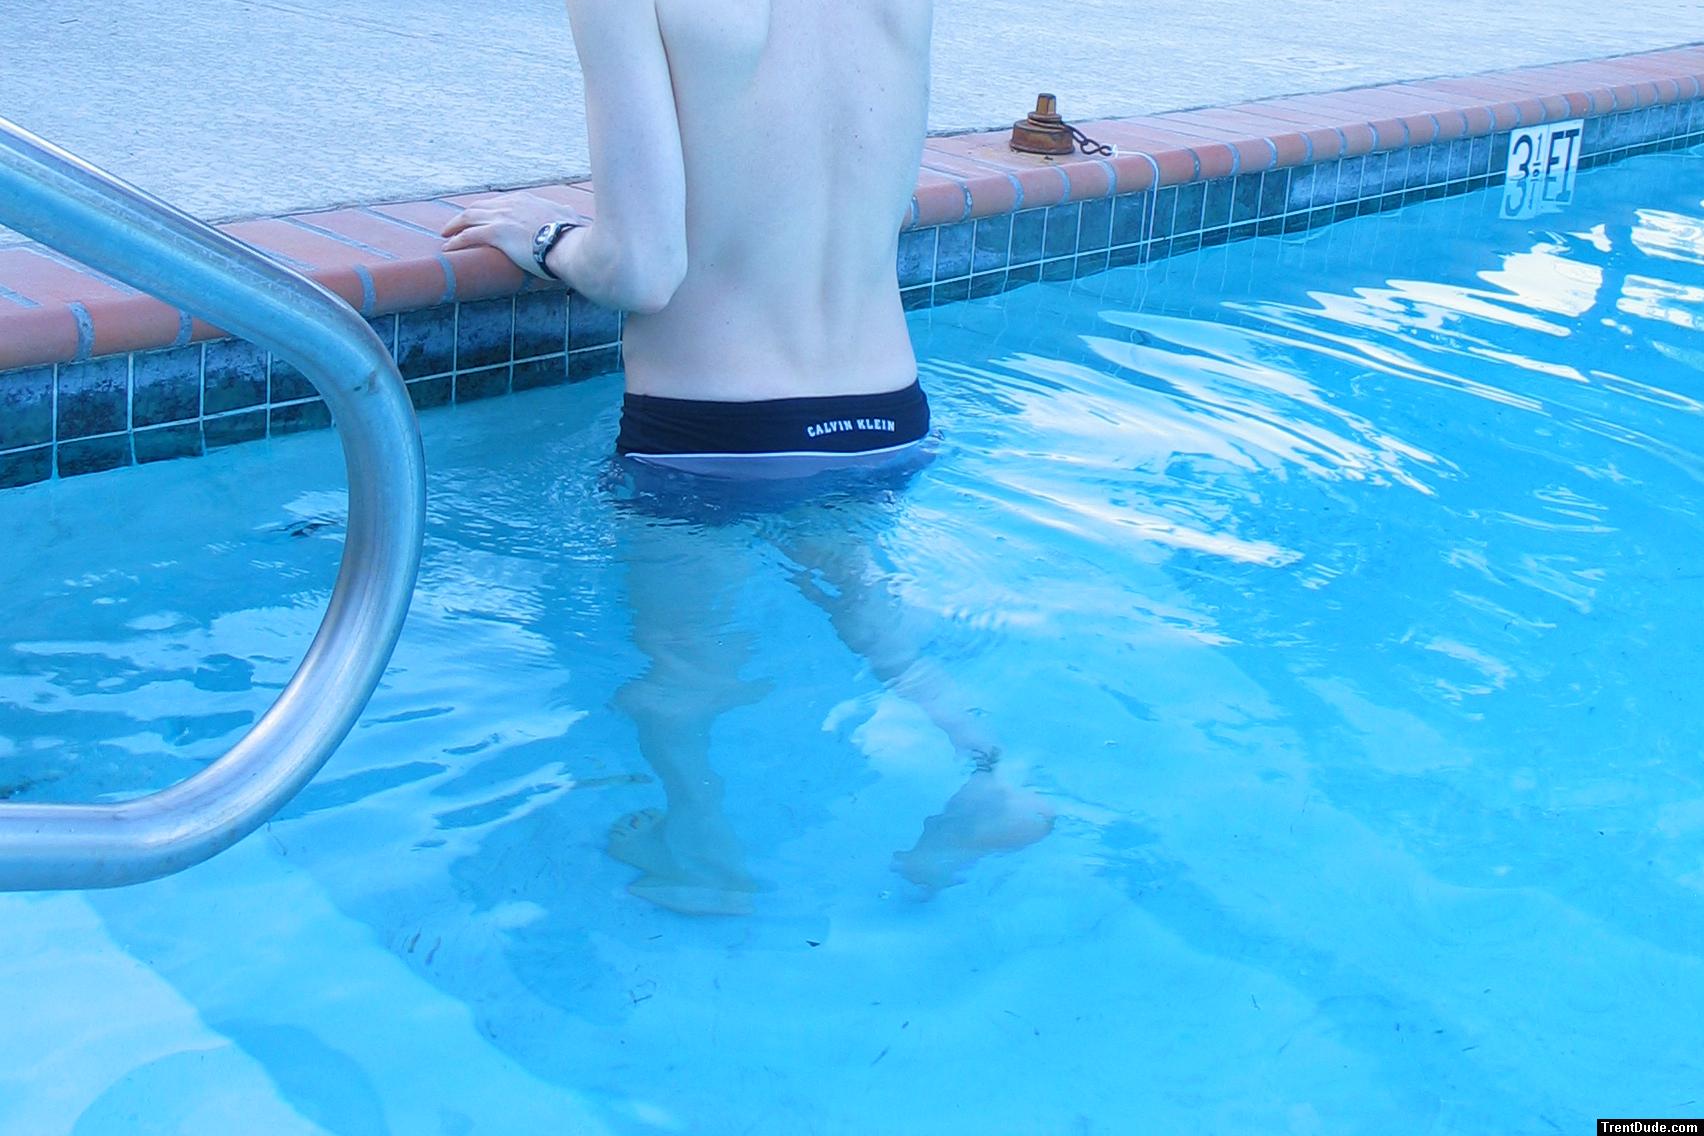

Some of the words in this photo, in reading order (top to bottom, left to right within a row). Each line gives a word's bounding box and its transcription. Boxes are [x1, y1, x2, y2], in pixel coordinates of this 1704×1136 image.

[1546, 128, 1580, 175] FT
[807, 420, 853, 438] CALVIN
[856, 418, 895, 432] KLEIN
